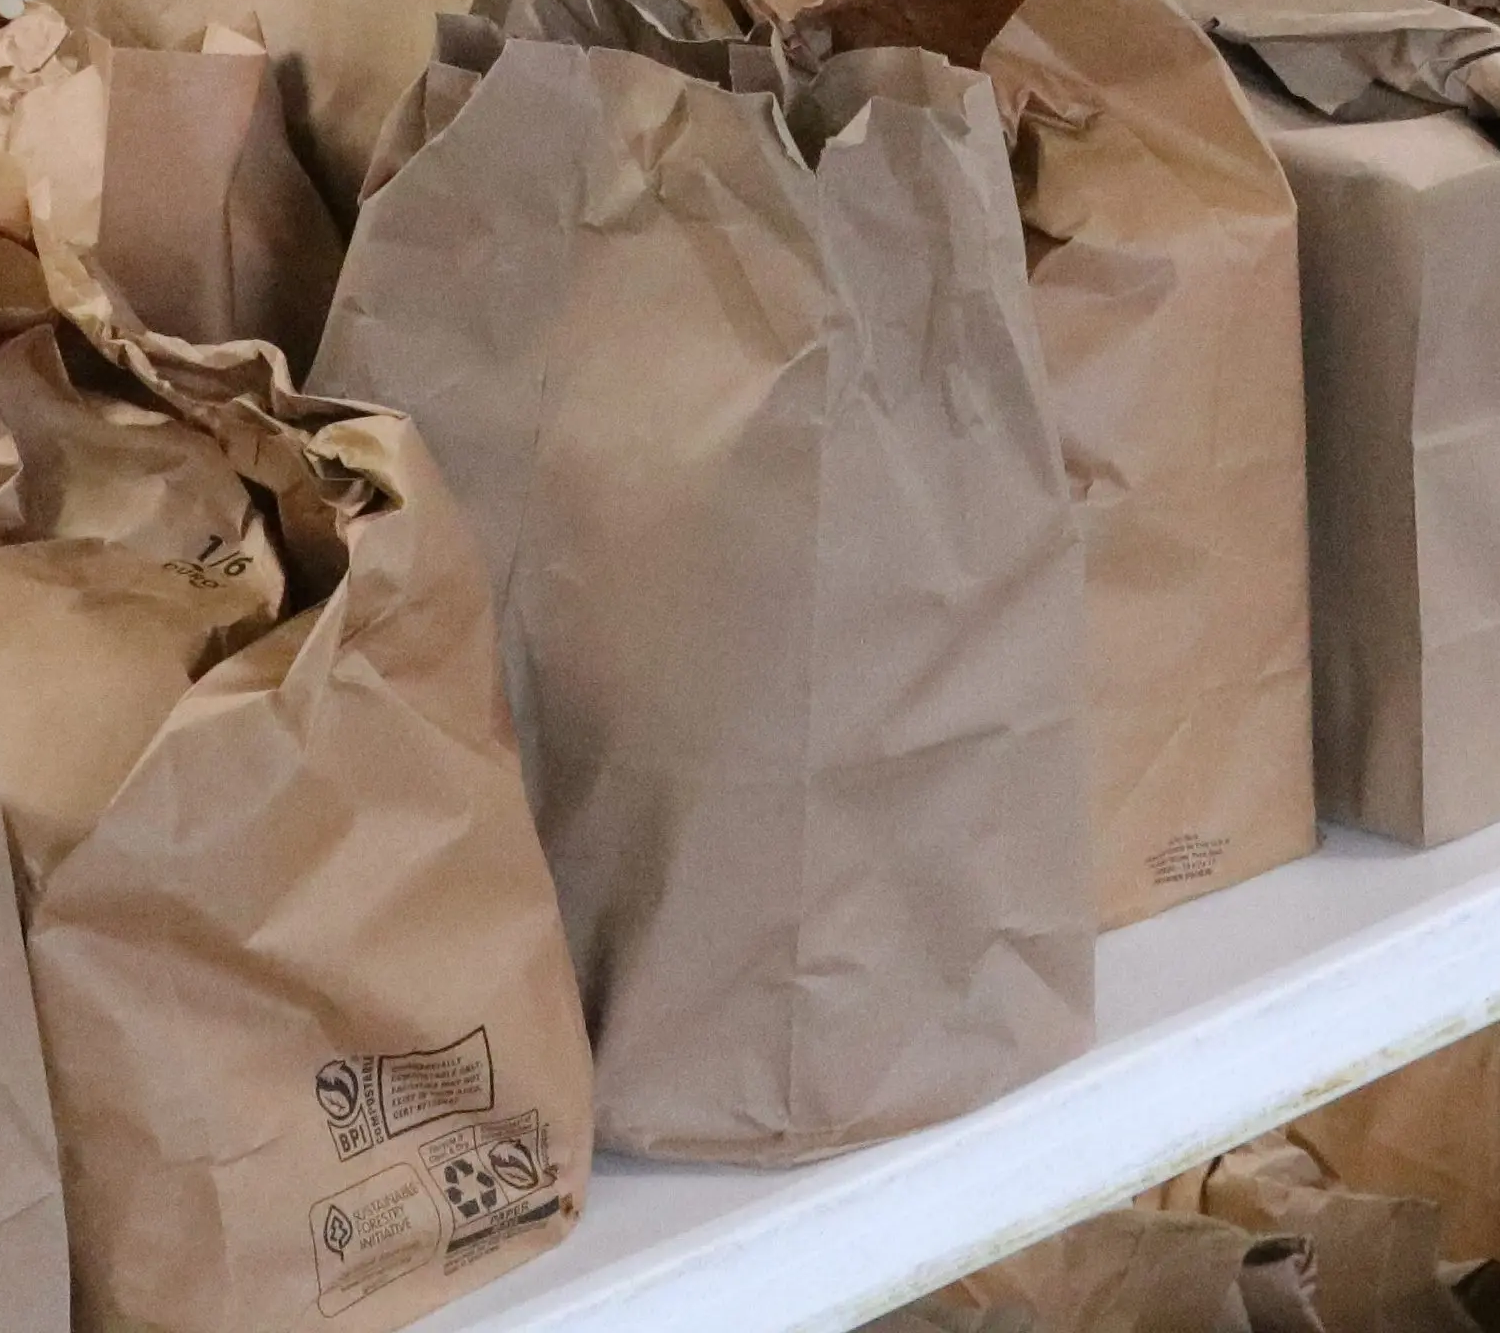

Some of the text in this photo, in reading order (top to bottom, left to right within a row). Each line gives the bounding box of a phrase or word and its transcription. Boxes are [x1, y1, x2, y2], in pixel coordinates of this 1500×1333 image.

[197, 534, 254, 576] 1/6
[338, 1124, 368, 1153] BPI
[356, 1205, 405, 1235] FORESTRY
[359, 1217, 412, 1250] INITIATIVE
